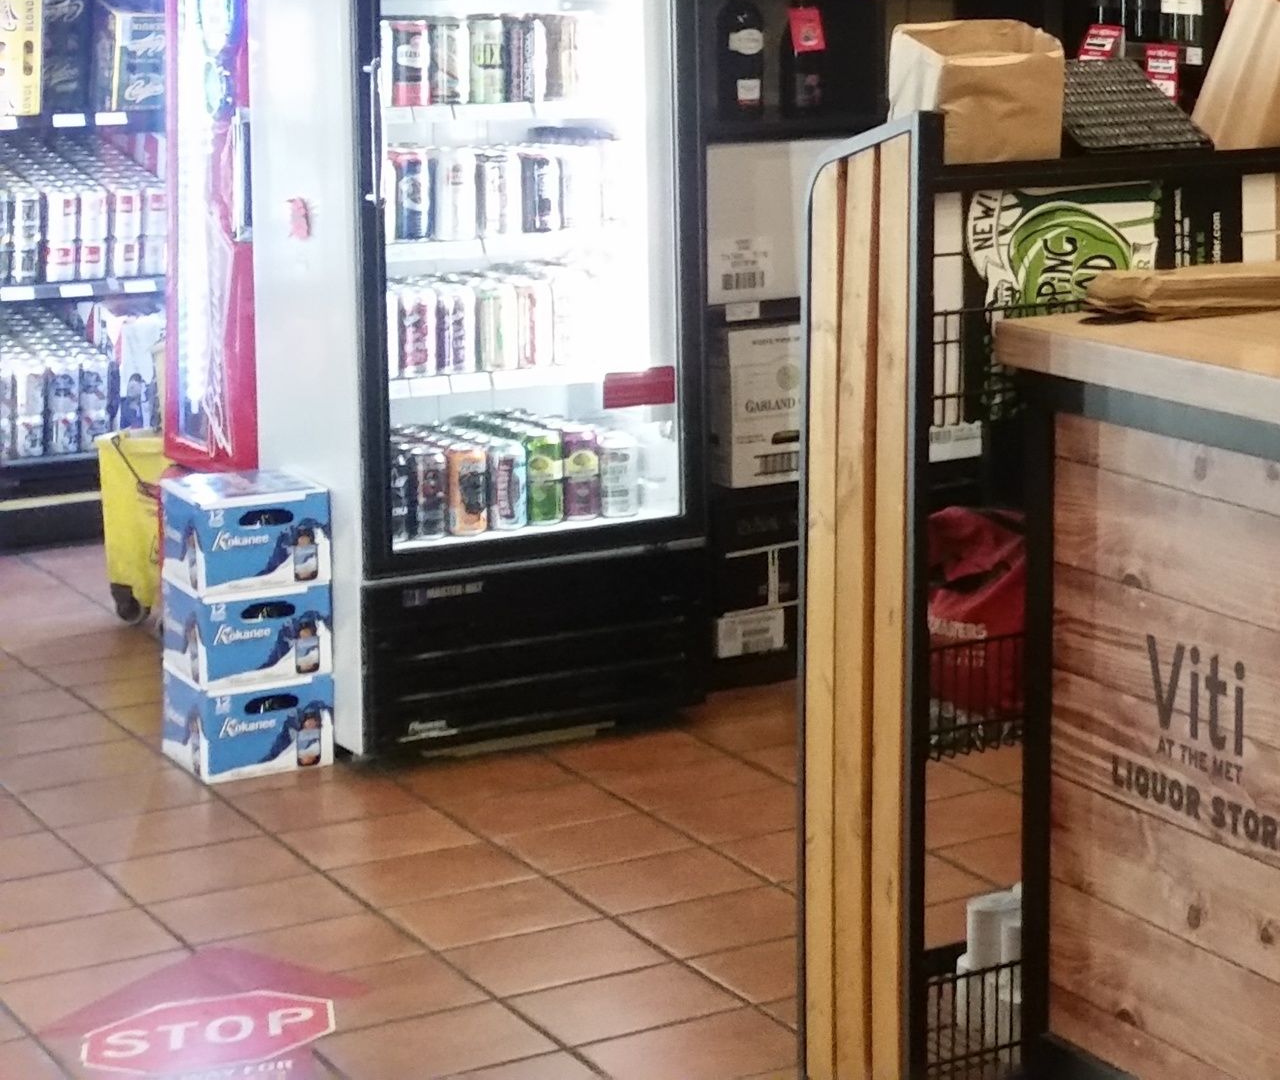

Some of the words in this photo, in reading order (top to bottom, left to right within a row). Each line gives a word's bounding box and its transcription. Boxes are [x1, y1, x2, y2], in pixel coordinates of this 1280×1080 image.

[971, 192, 1000, 252] NEW!
[745, 397, 796, 415] GARLAND
[211, 529, 270, 552] Kokanee
[213, 624, 271, 646] Kokanee
[1145, 631, 1249, 759] Viti
[218, 717, 277, 739] Kokanee
[1155, 736, 1176, 761] AT
[1179, 743, 1208, 775] THE
[1211, 757, 1243, 786] MET
[1110, 754, 1201, 822] LIQUOR
[101, 1006, 315, 1059] STOP
